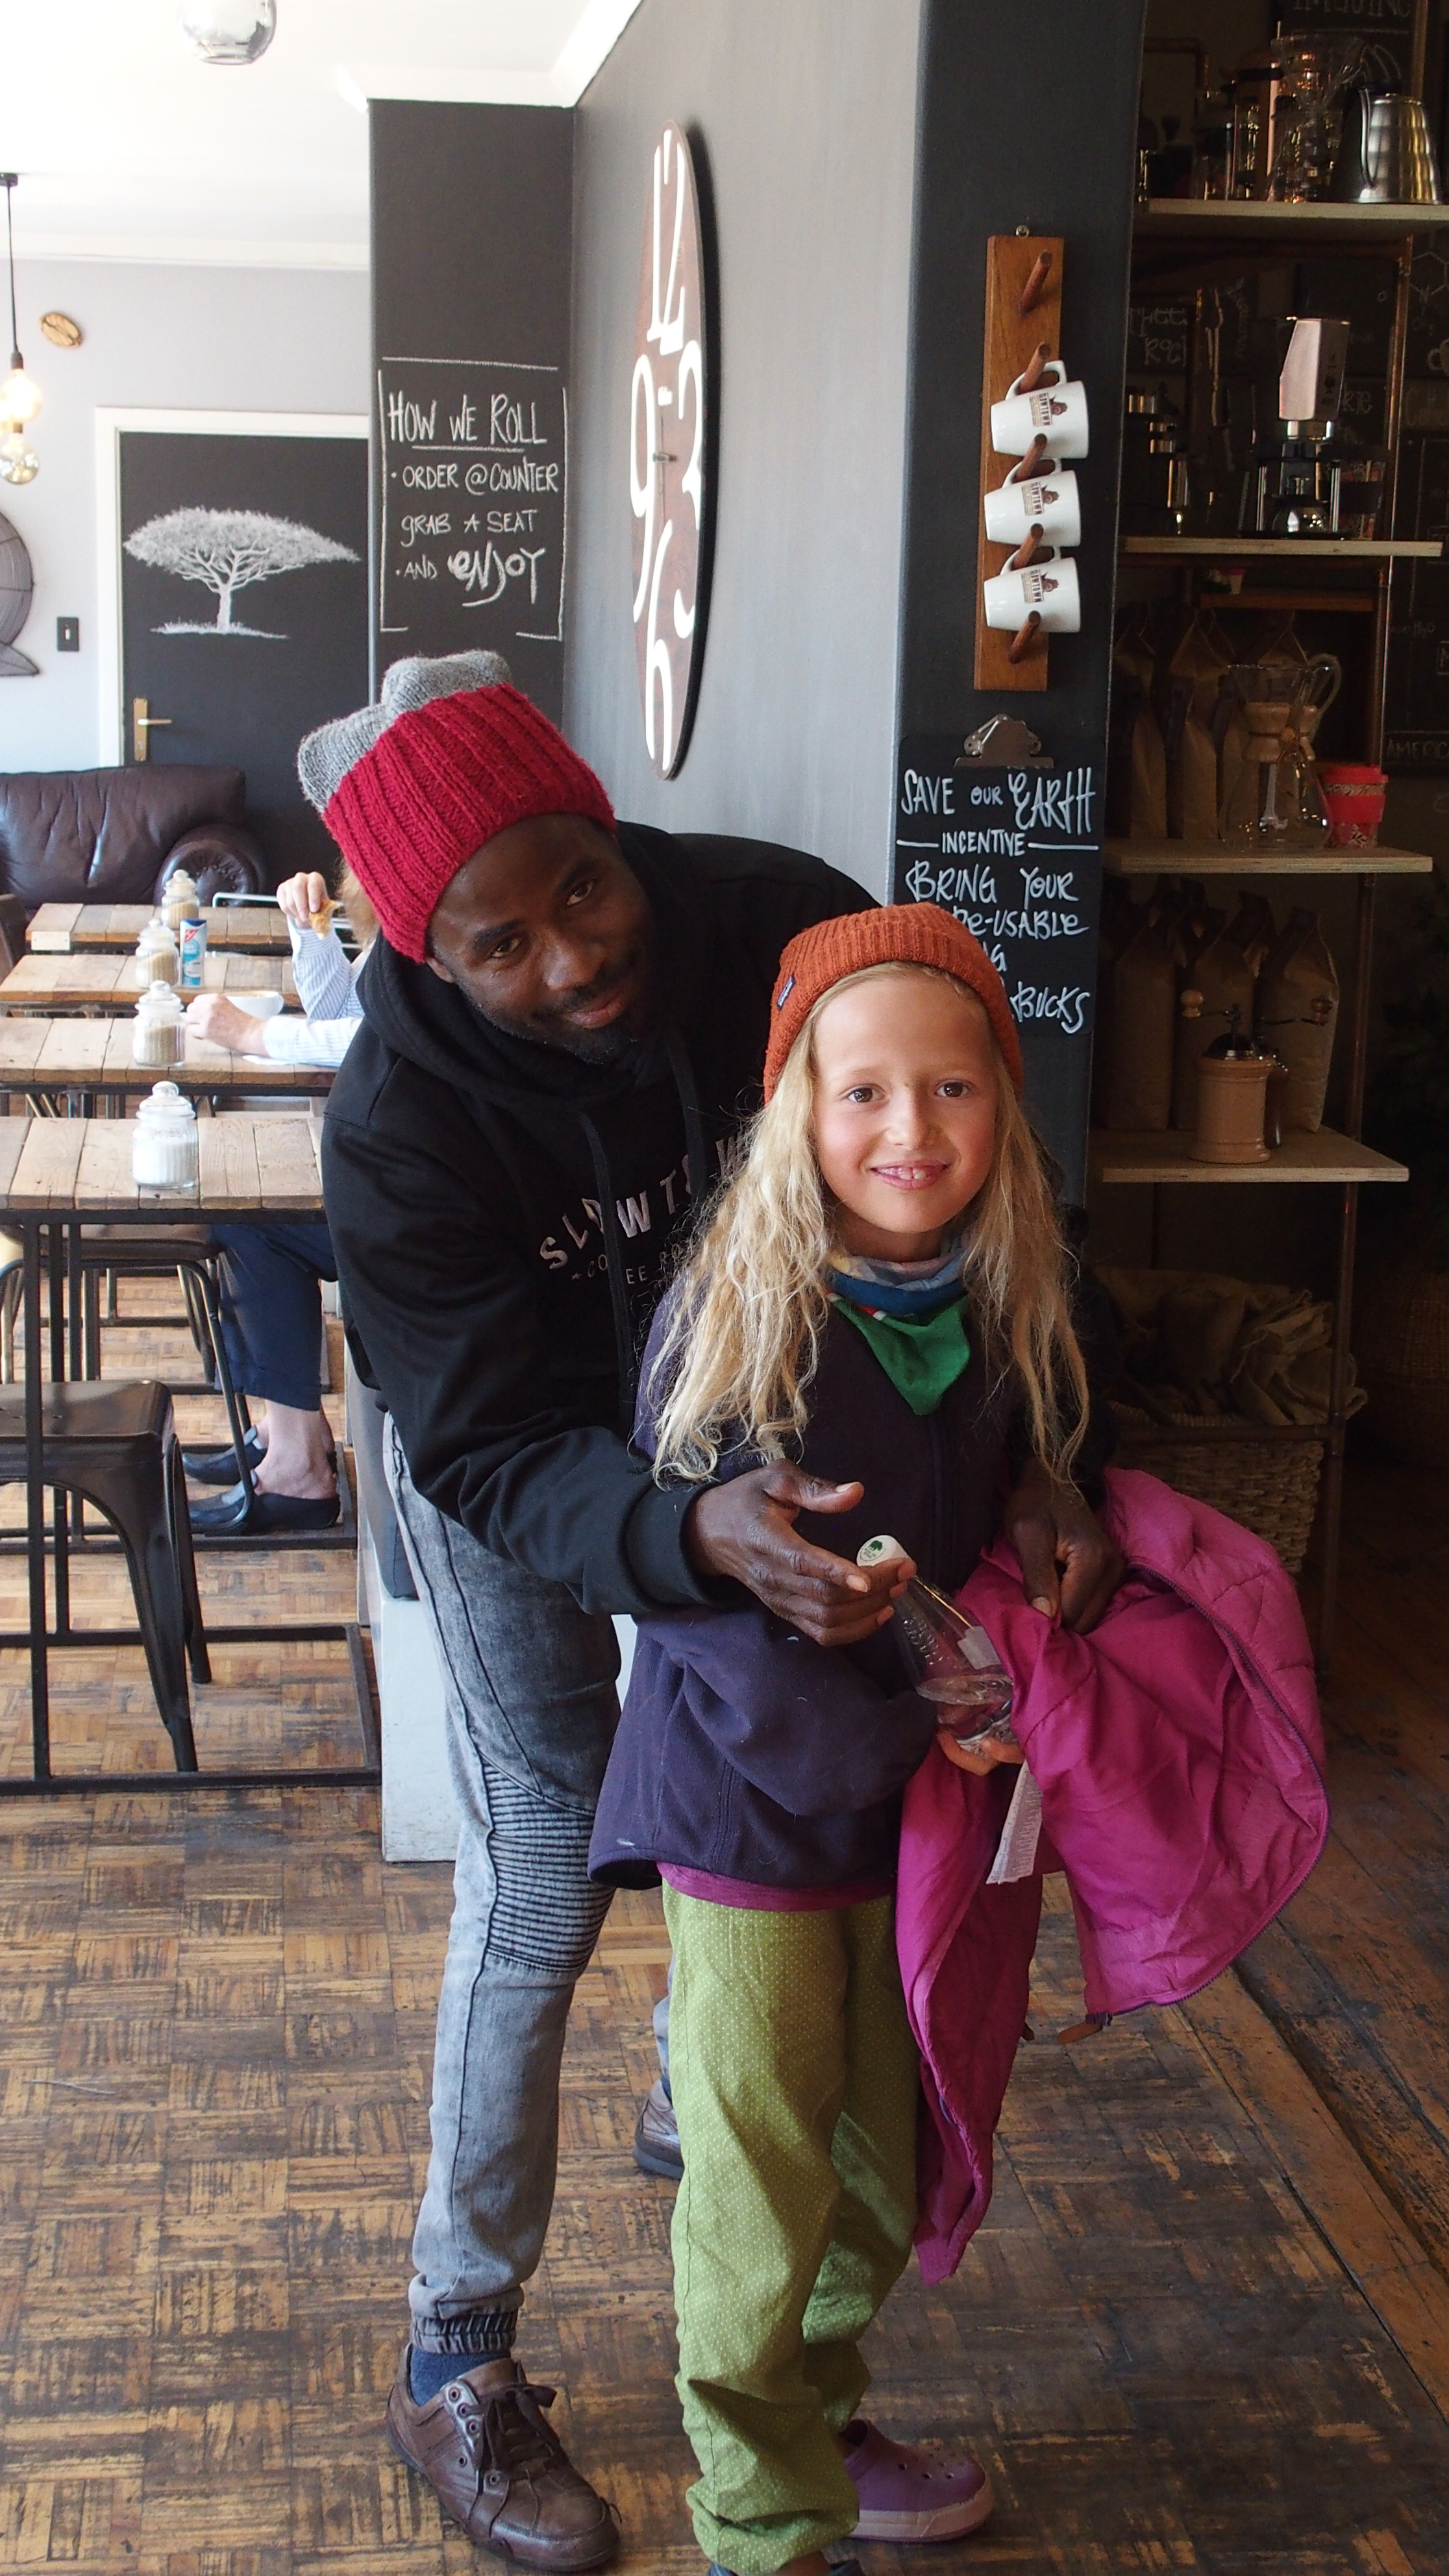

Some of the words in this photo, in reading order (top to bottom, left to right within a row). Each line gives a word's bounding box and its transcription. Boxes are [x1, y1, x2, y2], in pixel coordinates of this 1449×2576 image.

[647, 129, 686, 356] 12
[388, 391, 437, 442] HOW
[449, 394, 478, 441] WE
[491, 393, 547, 445] ROLL
[402, 464, 458, 491] ORDER
[630, 354, 656, 623] 9
[464, 514, 480, 532] A
[487, 510, 538, 533] SEAT
[404, 554, 438, 579] AND
[645, 519, 673, 771] 6
[901, 769, 956, 815] SAVE
[971, 786, 1004, 806] OUR
[1008, 767, 1096, 835] EARTH
[942, 828, 1026, 857] INCENTIVE
[905, 860, 997, 903] BRING
[1020, 867, 1080, 910] YOUR
[1009, 981, 1091, 1034] BUCKS
[587, 1254, 648, 1285] COEE
